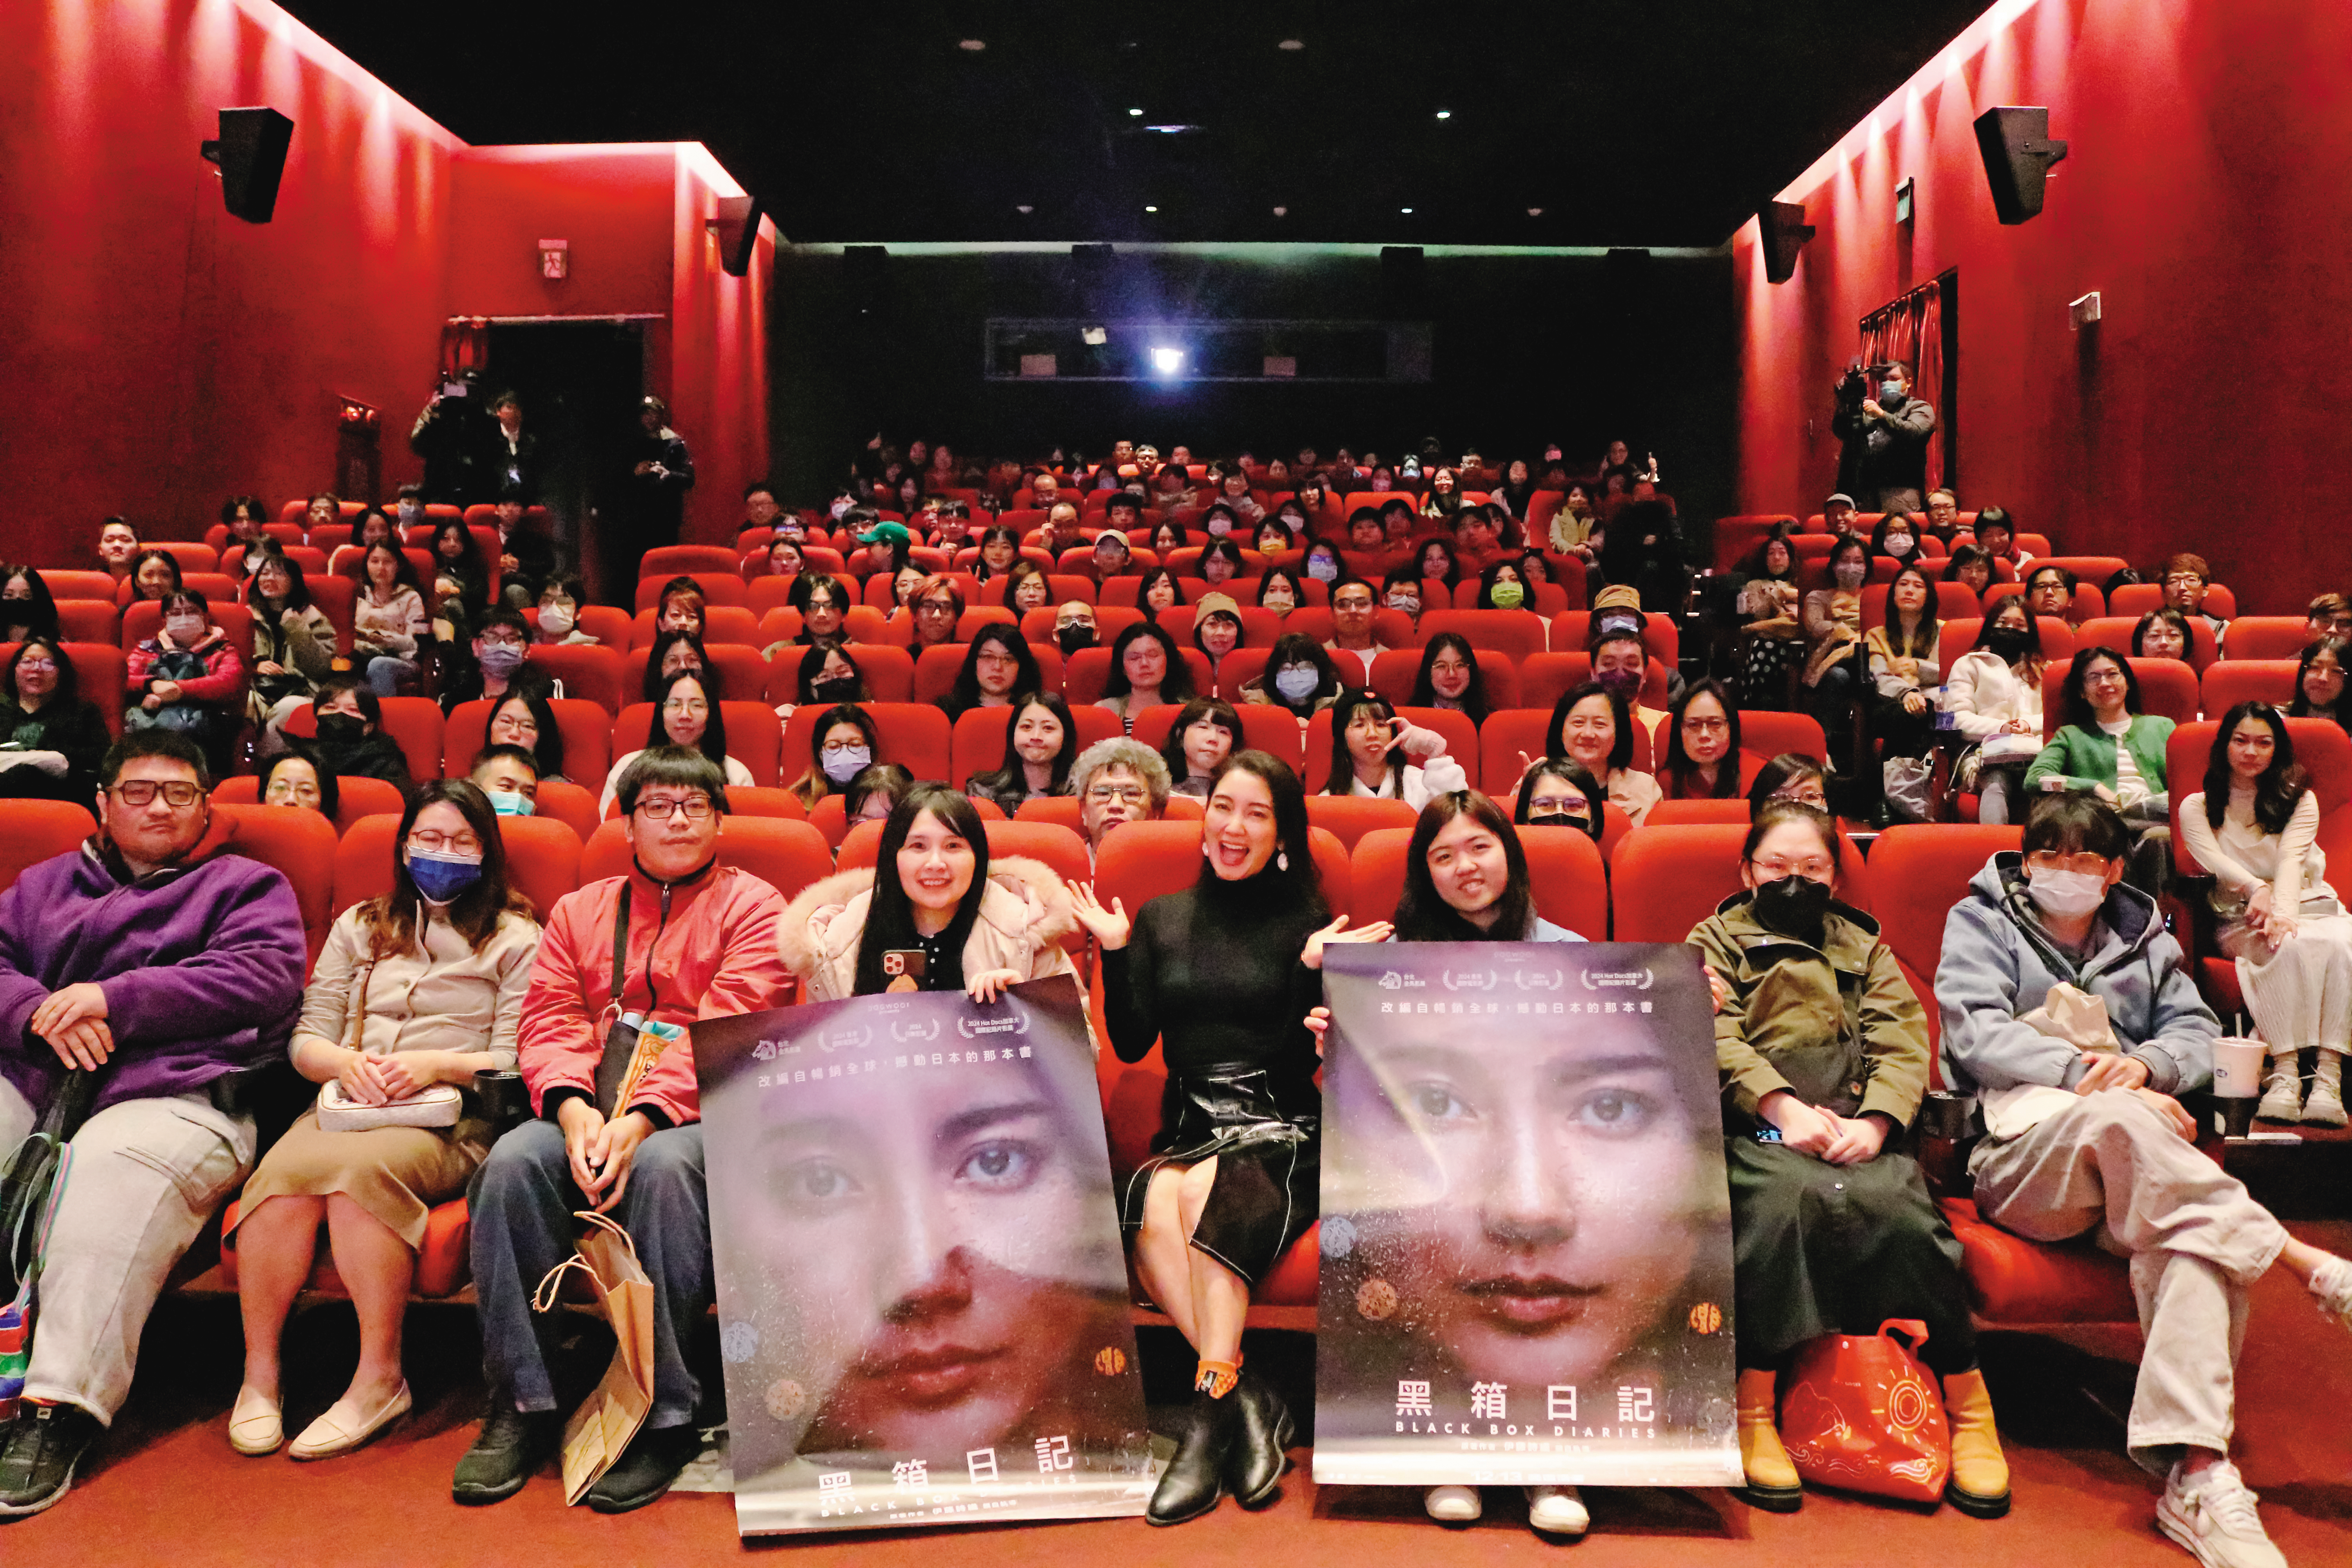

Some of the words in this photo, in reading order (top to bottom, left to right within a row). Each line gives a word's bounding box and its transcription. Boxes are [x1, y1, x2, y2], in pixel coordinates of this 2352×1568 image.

[1396, 1380, 1655, 1422] 黑箱日記
[1396, 1421, 1470, 1434] BLACK
[1490, 1424, 1534, 1436] BOX
[1554, 1426, 1655, 1438] DIARIES
[818, 1435, 1073, 1506] 黑箱日記
[821, 1500, 897, 1517] BLACK
[916, 1493, 960, 1506] BOX
[980, 1474, 1076, 1497] DIES
